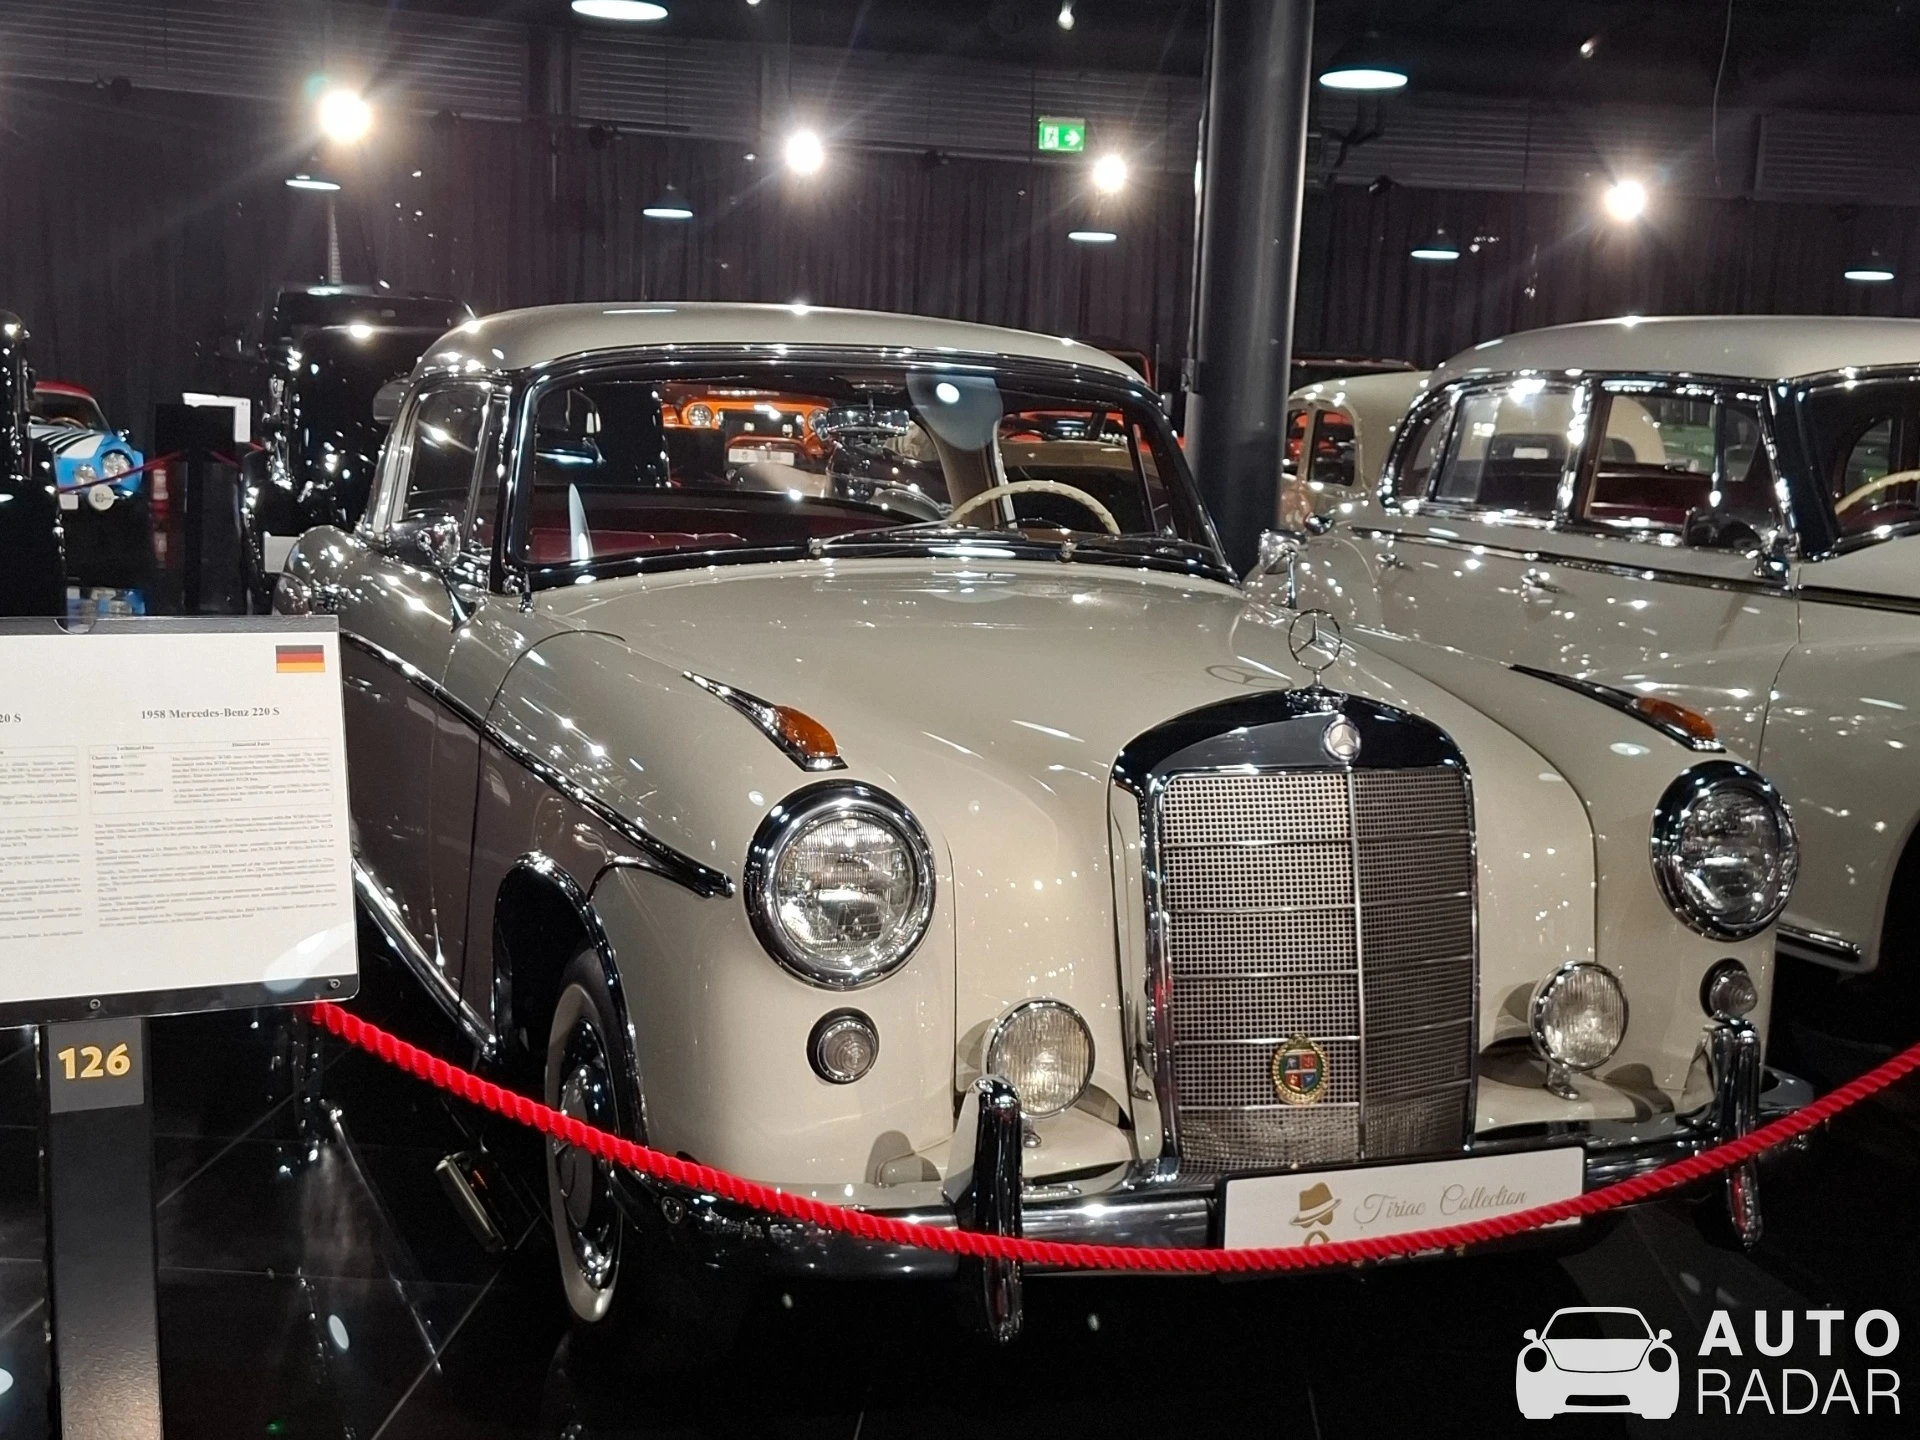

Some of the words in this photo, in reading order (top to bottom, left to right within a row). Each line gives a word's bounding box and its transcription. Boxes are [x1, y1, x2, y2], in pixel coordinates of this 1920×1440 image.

[14, 712, 22, 723] S
[141, 710, 166, 719] 1958
[169, 708, 249, 719] Mercedes-Benz
[252, 707, 270, 716] 220
[273, 707, 280, 715] S
[58, 1043, 131, 1079] 126
[1440, 1184, 1527, 1216] Collection
